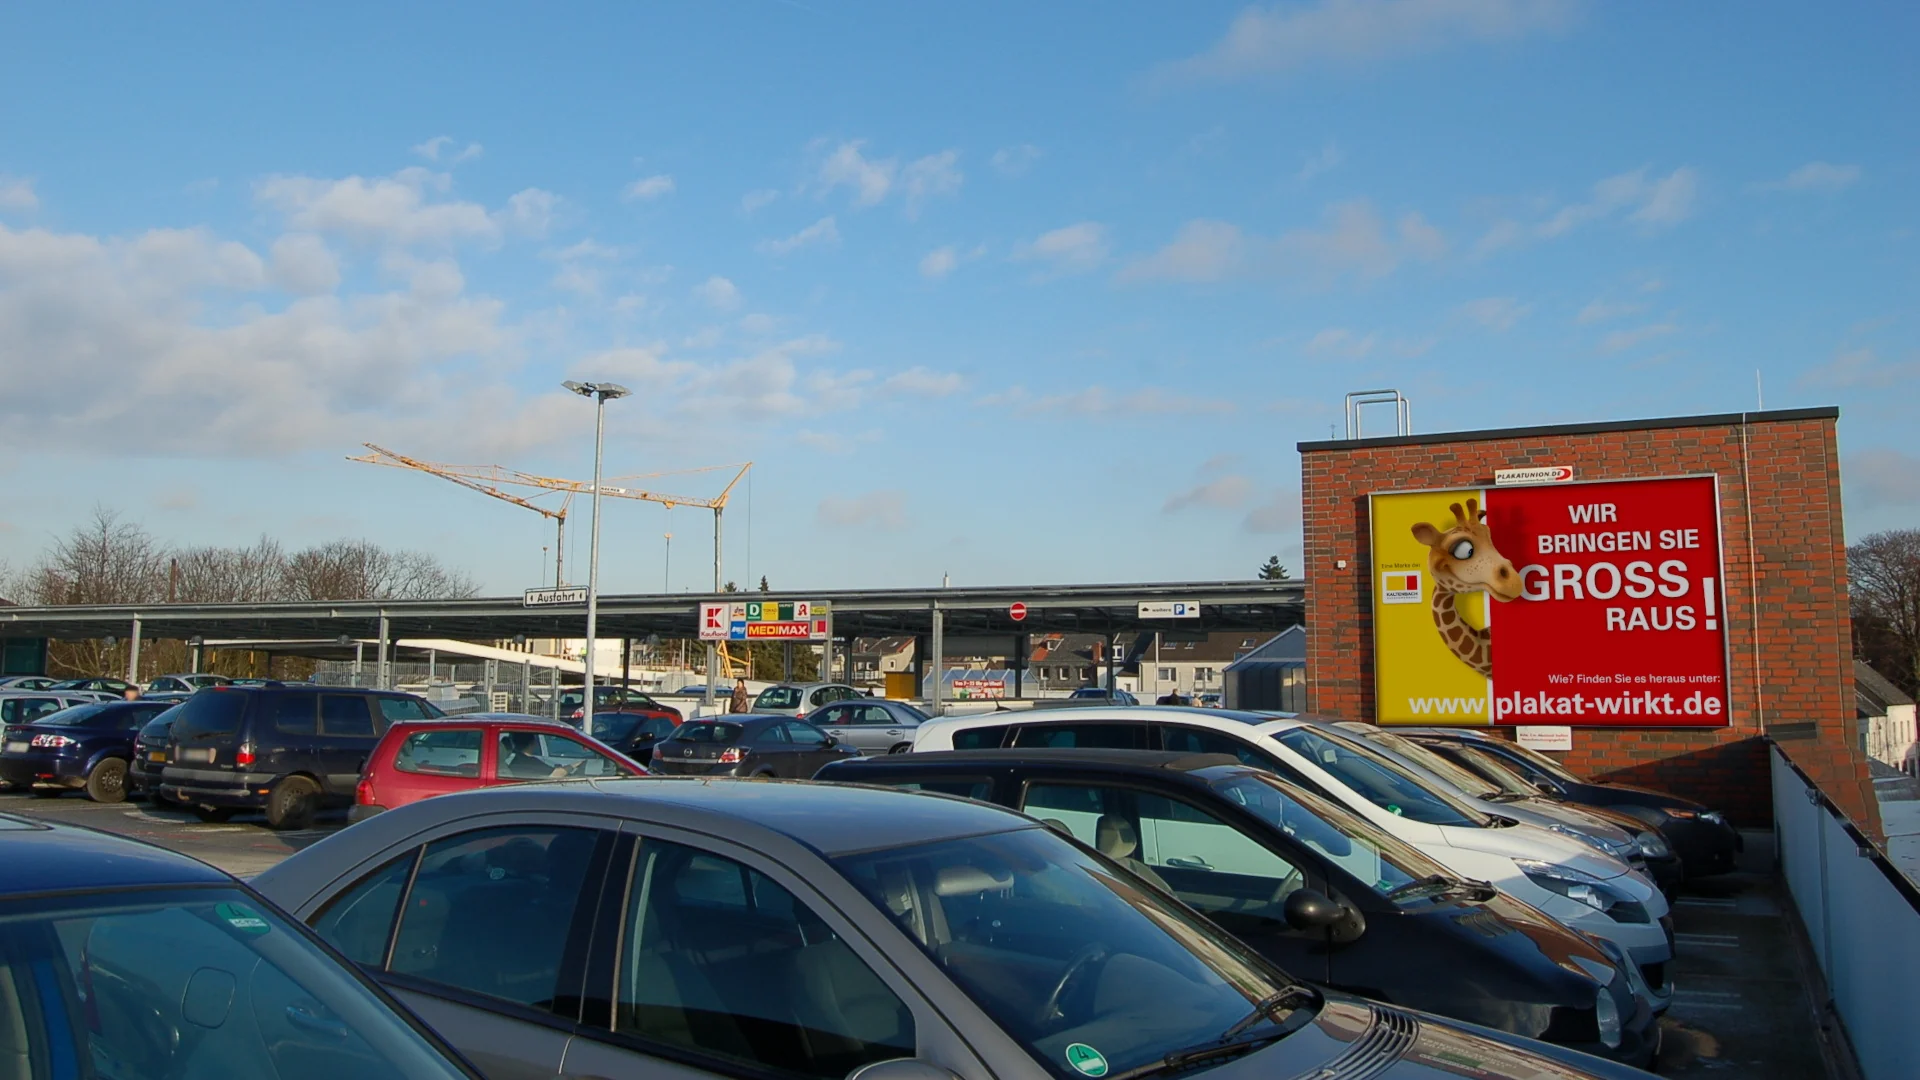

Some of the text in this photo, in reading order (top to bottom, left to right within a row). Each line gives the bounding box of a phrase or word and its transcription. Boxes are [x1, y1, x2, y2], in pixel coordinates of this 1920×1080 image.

[1497, 470, 1562, 480] PLAKATUNION.DE
[1568, 503, 1617, 524] WIR
[1538, 528, 1700, 554] BRINGEN SIE
[1520, 559, 1690, 601] GROSS
[537, 592, 575, 602] Ausfahrt
[1606, 606, 1697, 631] RAUS
[748, 625, 808, 635] MEDIMAX
[1548, 674, 1574, 684] Wie?
[1577, 674, 1612, 683] Finden
[1614, 674, 1631, 683] Sie
[1649, 674, 1686, 683] heraus
[1688, 674, 1721, 683] unter:
